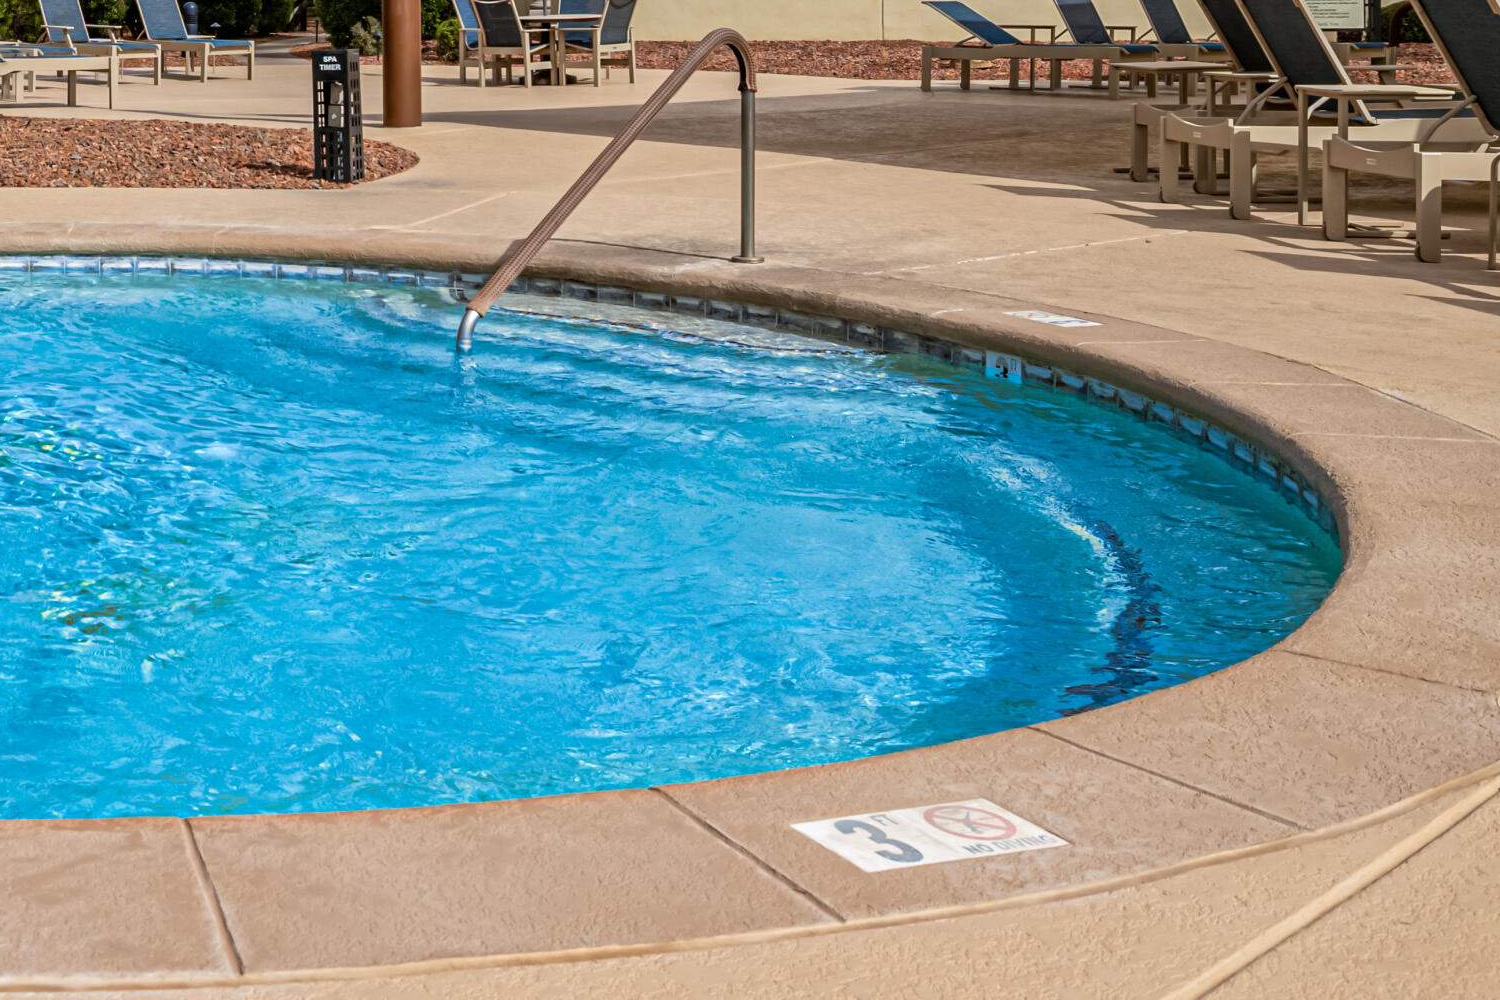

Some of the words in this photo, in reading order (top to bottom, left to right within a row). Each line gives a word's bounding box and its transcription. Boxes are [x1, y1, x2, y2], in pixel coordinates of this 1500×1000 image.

[868, 814, 899, 827] FT
[833, 819, 924, 863] 3
[962, 843, 995, 855] NO
